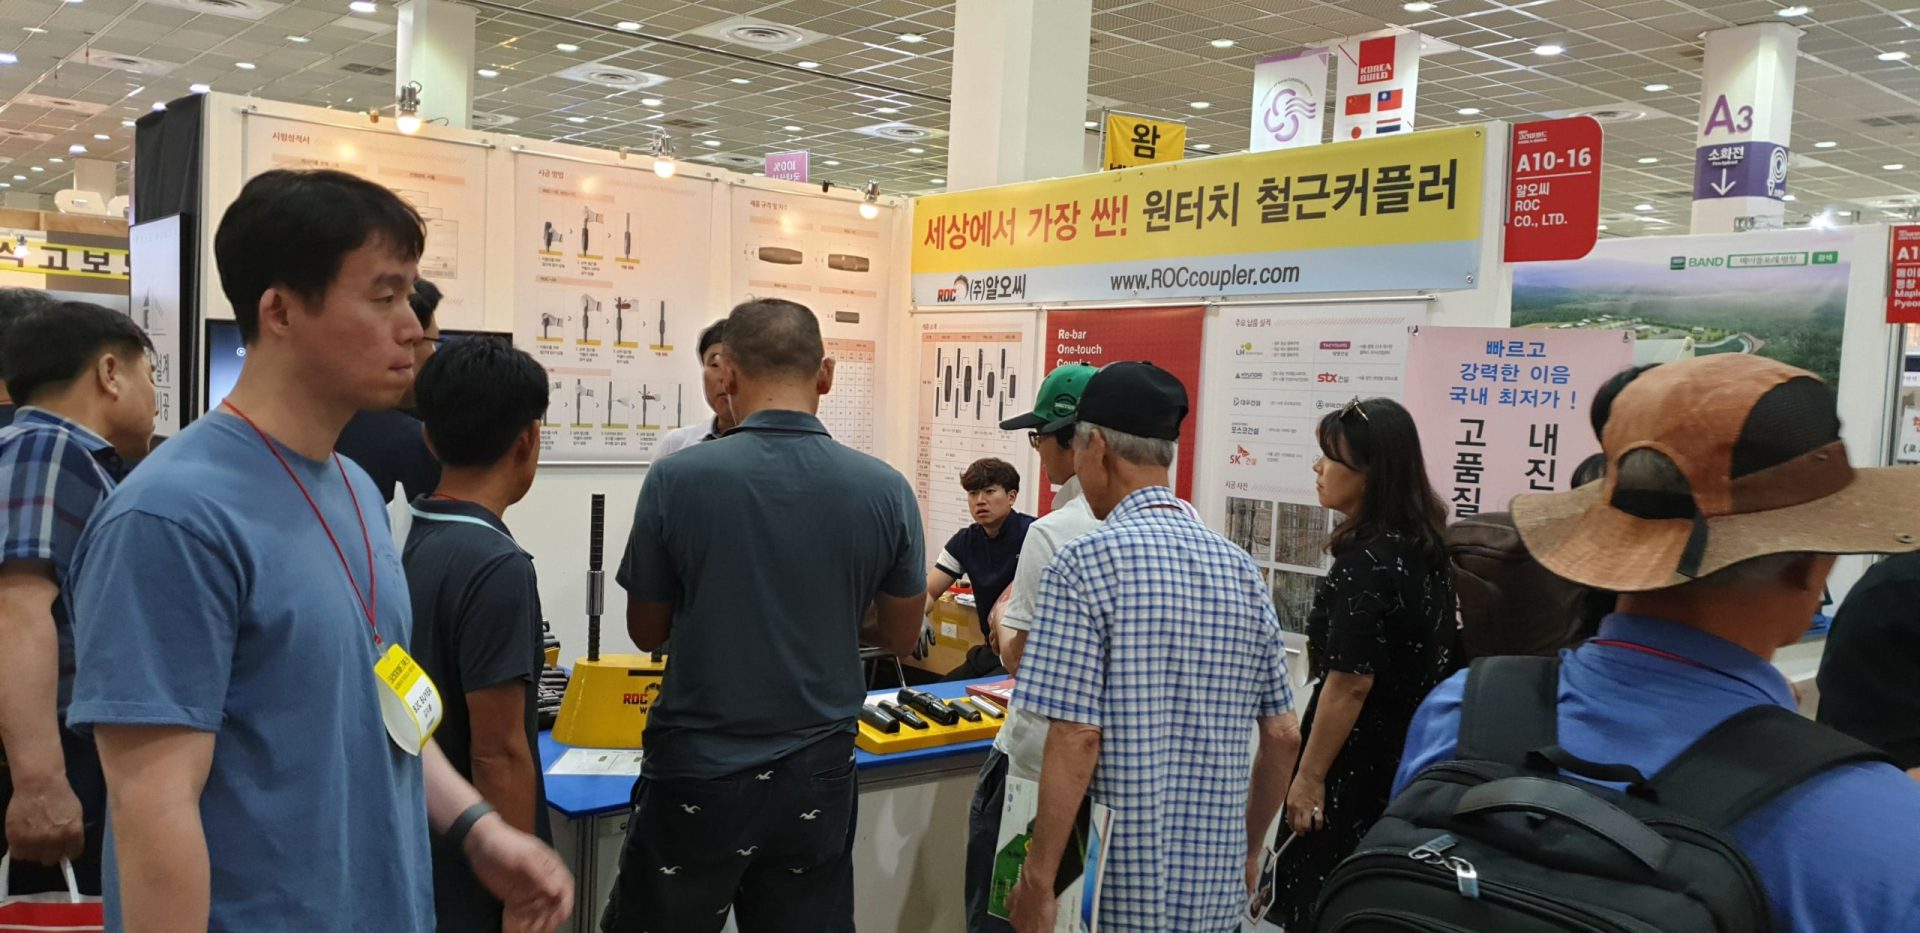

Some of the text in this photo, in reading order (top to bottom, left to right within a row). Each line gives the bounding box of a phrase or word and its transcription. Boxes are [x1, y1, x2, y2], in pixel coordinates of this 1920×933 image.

[1360, 63, 1392, 75] KOREA
[1360, 72, 1388, 82] BUILD
[1704, 94, 1753, 136] A3
[1516, 147, 1592, 173] A10-16
[1708, 146, 1745, 161] 소화전
[1516, 182, 1550, 198] 알오씨
[924, 158, 1458, 251] 세상에서 가장 싼! 원터치 철근커플러
[1515, 199, 1540, 212] ROC
[1514, 213, 1568, 227] CO., LTD.
[1689, 257, 1724, 267] BAND
[1110, 263, 1300, 291] www.ROCcoupler.com
[969, 274, 1027, 301] (주)알오씨
[937, 289, 956, 302] ROC
[1058, 329, 1087, 340] Re-bar
[1057, 344, 1102, 355] One-touch
[1486, 339, 1547, 358] 빠르고
[1460, 363, 1571, 384] 강력한 이음
[1449, 386, 1488, 405] 국내
[1498, 388, 1561, 408] 최저가
[1229, 455, 1241, 465] SK
[623, 693, 648, 704] ROC
